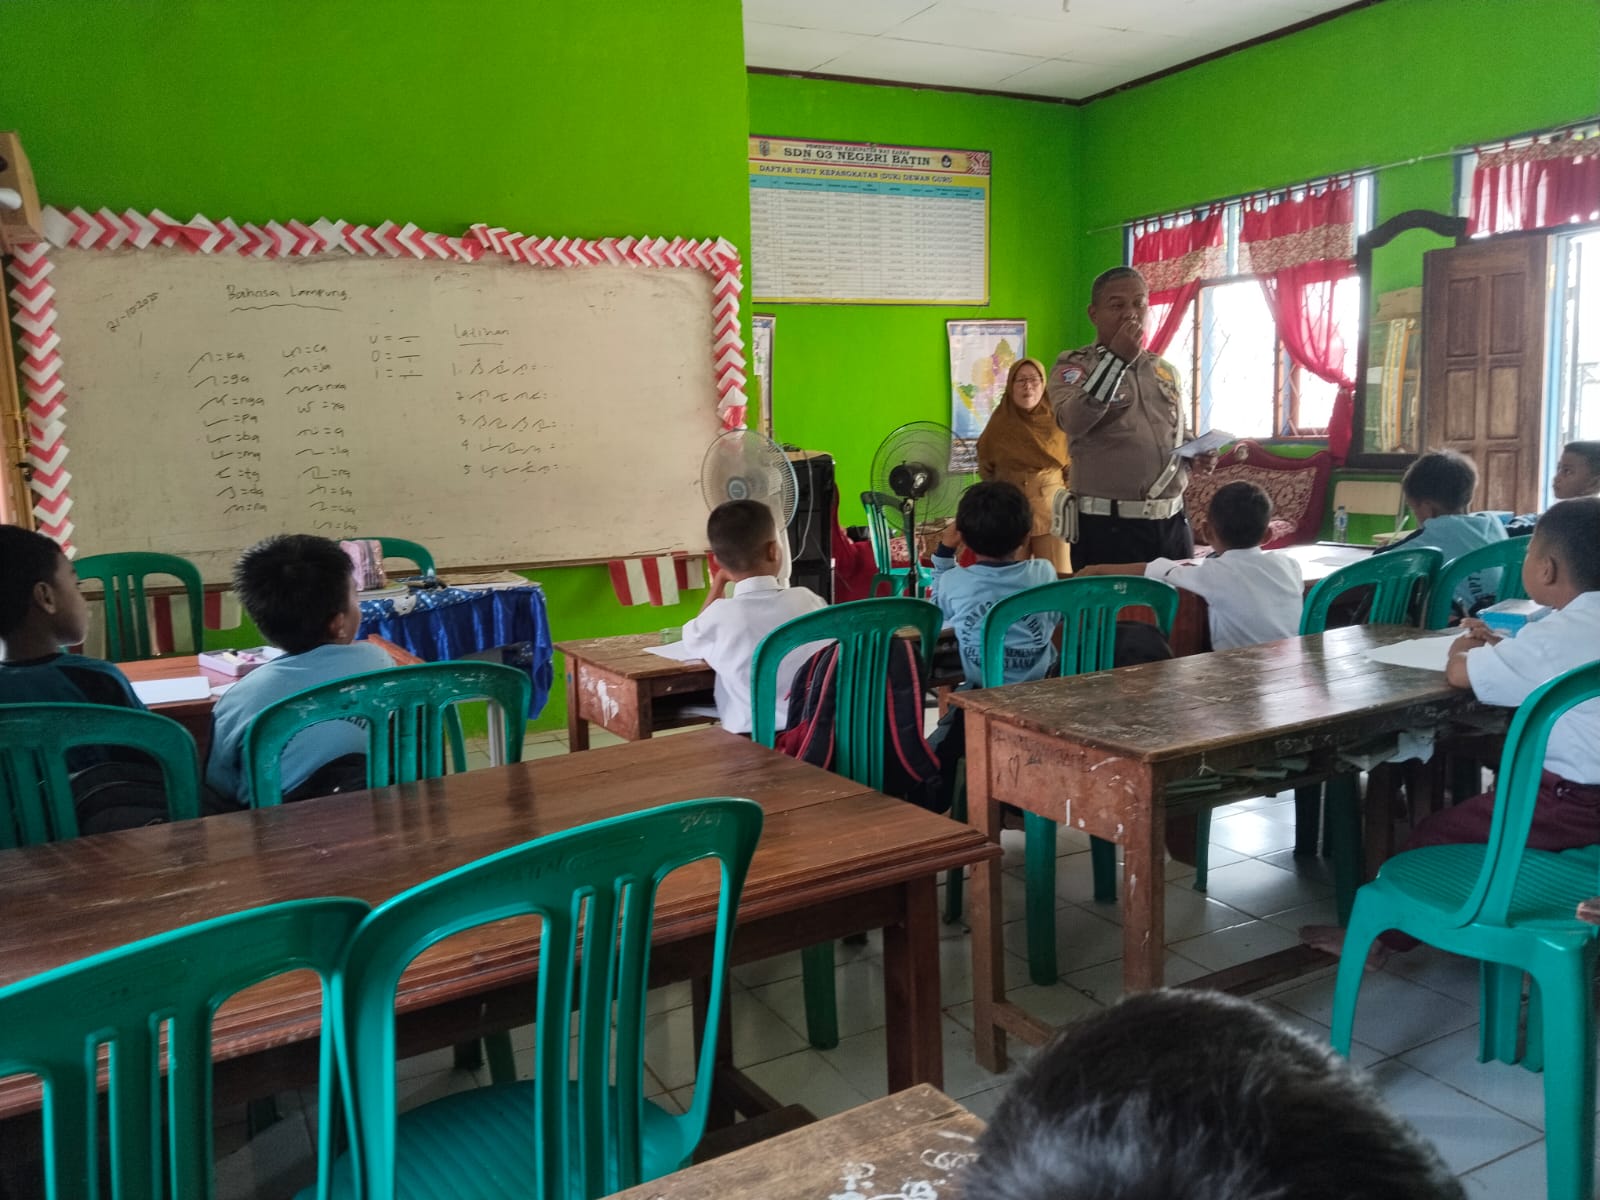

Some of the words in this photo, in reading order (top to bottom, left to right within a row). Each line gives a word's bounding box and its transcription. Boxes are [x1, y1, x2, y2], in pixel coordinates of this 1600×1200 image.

[784, 147, 811, 158] SDN
[816, 150, 833, 160] 03
[837, 151, 887, 163] NEGERI
[892, 154, 931, 166] BATIN
[760, 164, 792, 174] DAFTAR
